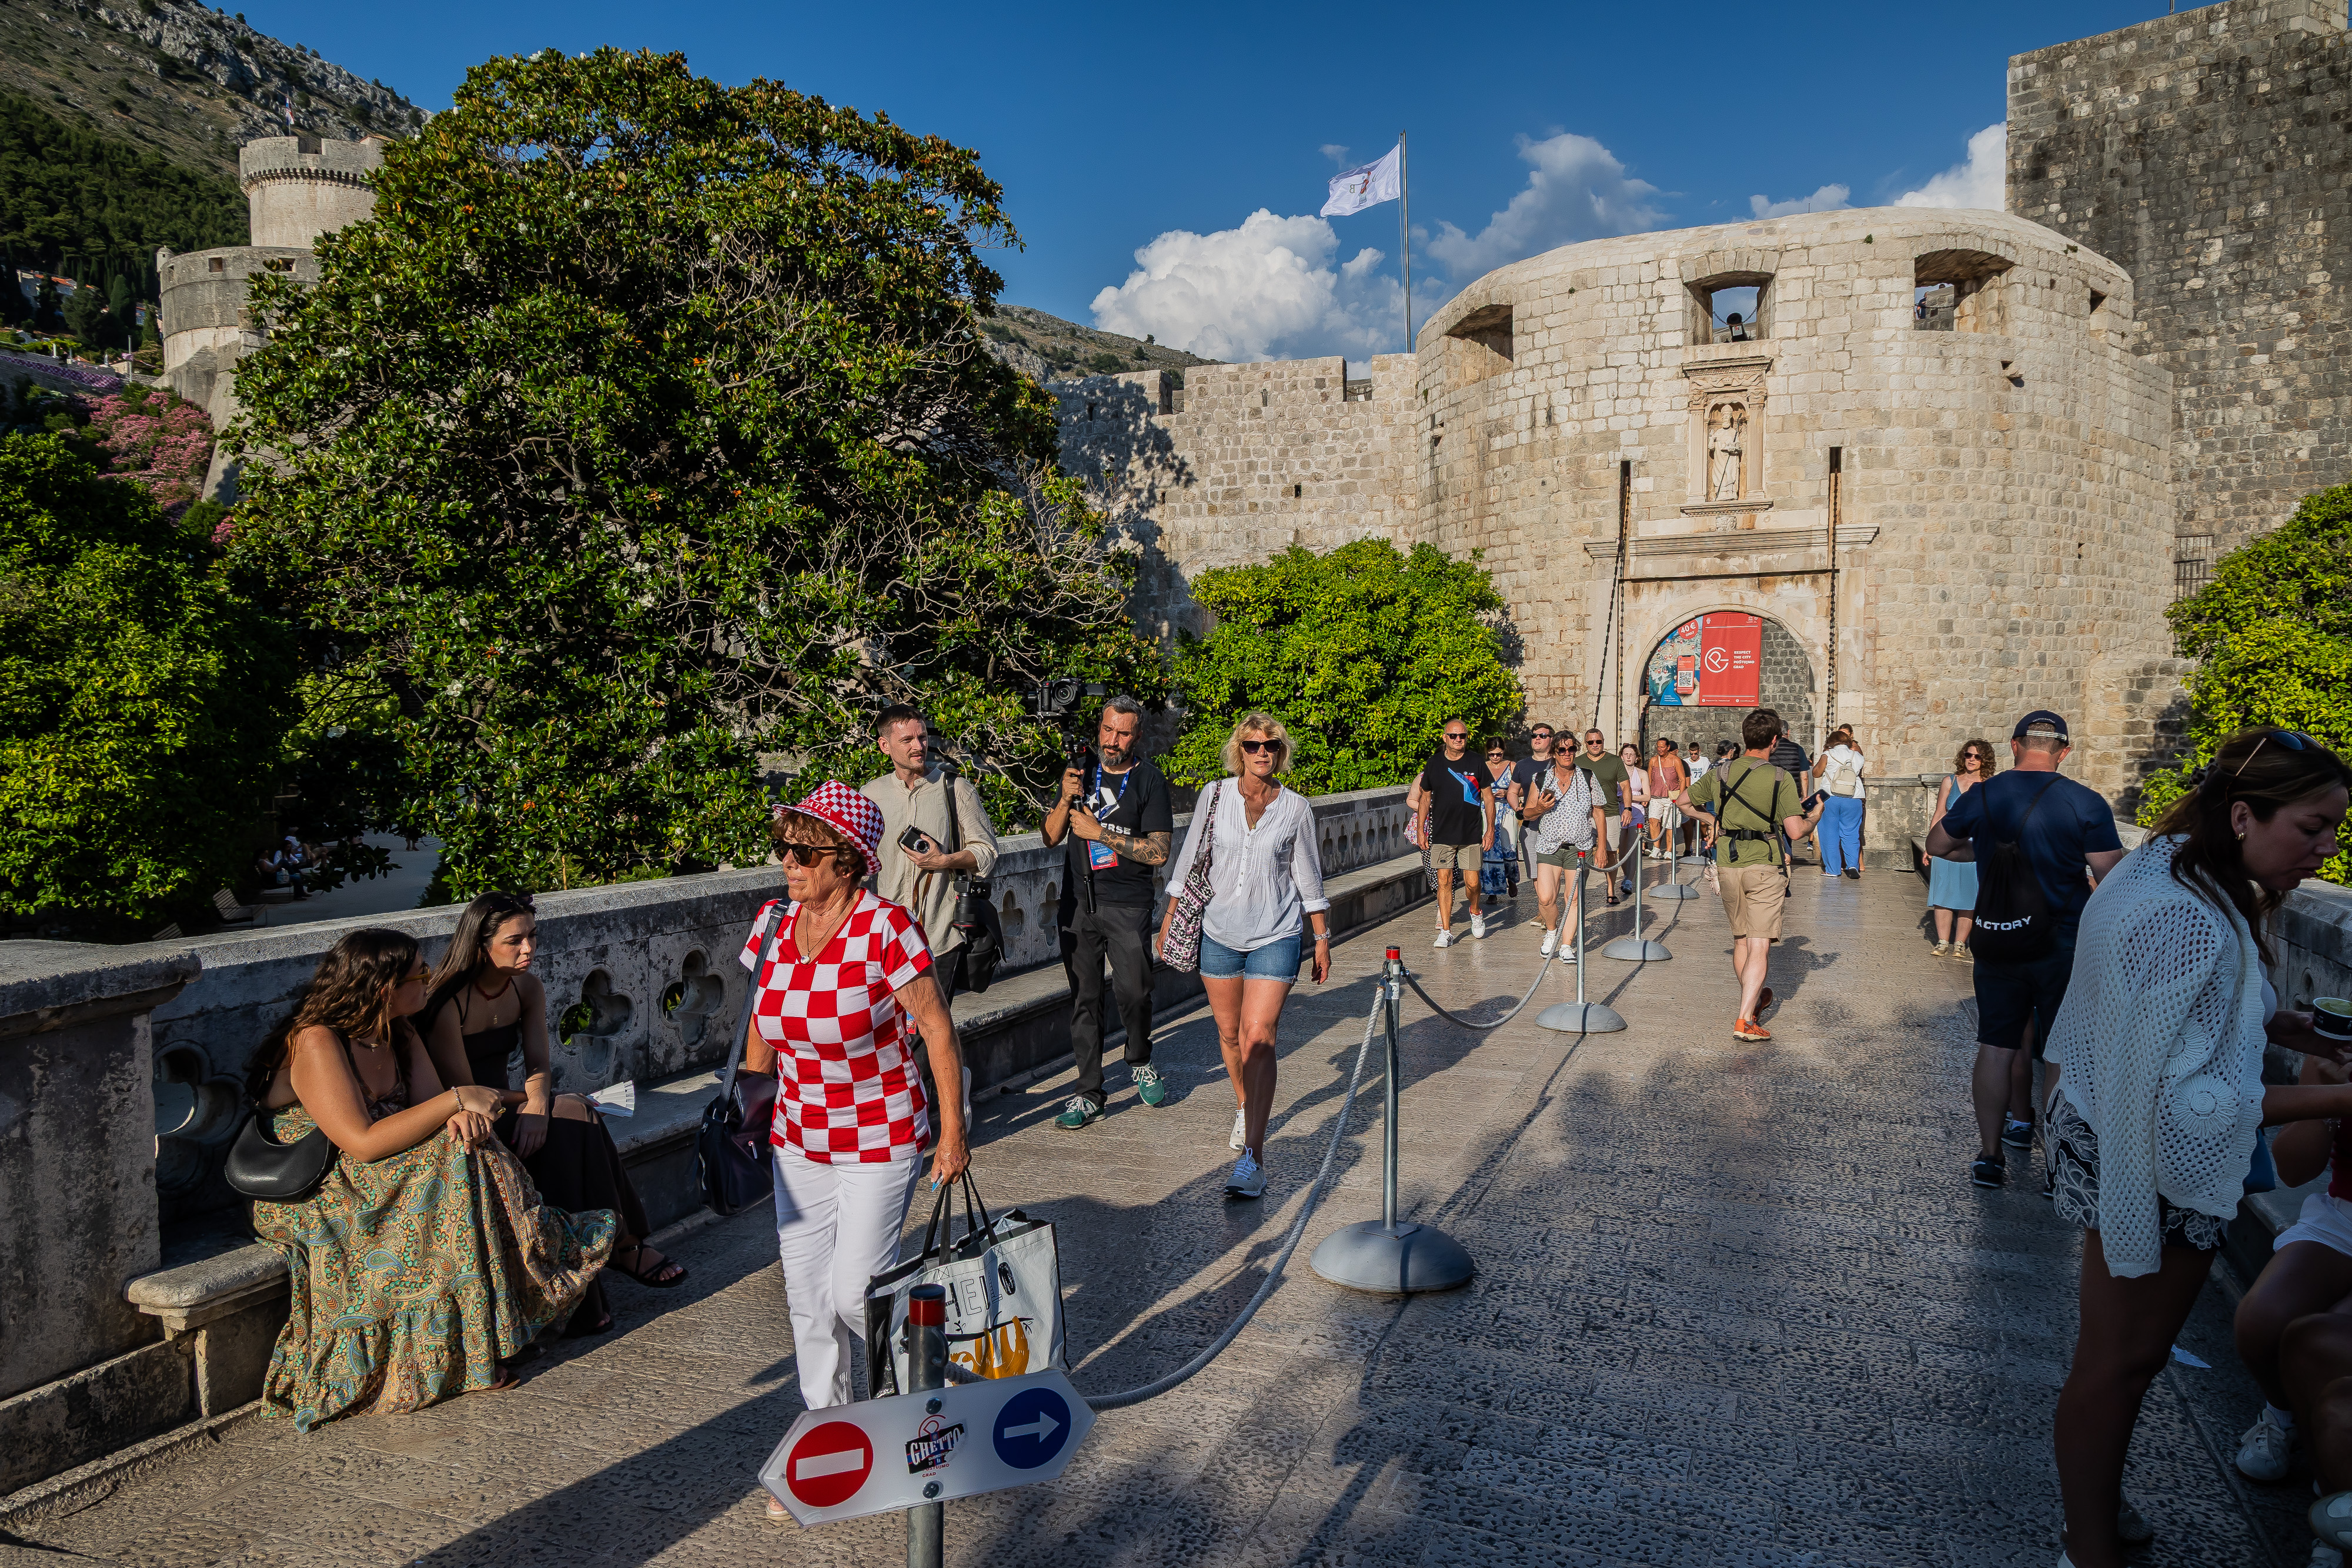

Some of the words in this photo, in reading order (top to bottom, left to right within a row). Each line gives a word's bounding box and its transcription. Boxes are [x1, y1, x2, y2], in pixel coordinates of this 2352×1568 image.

[798, 800, 831, 817] OATIA
[1100, 821, 1131, 835] ERSE
[910, 1427, 961, 1465] GHETTO
